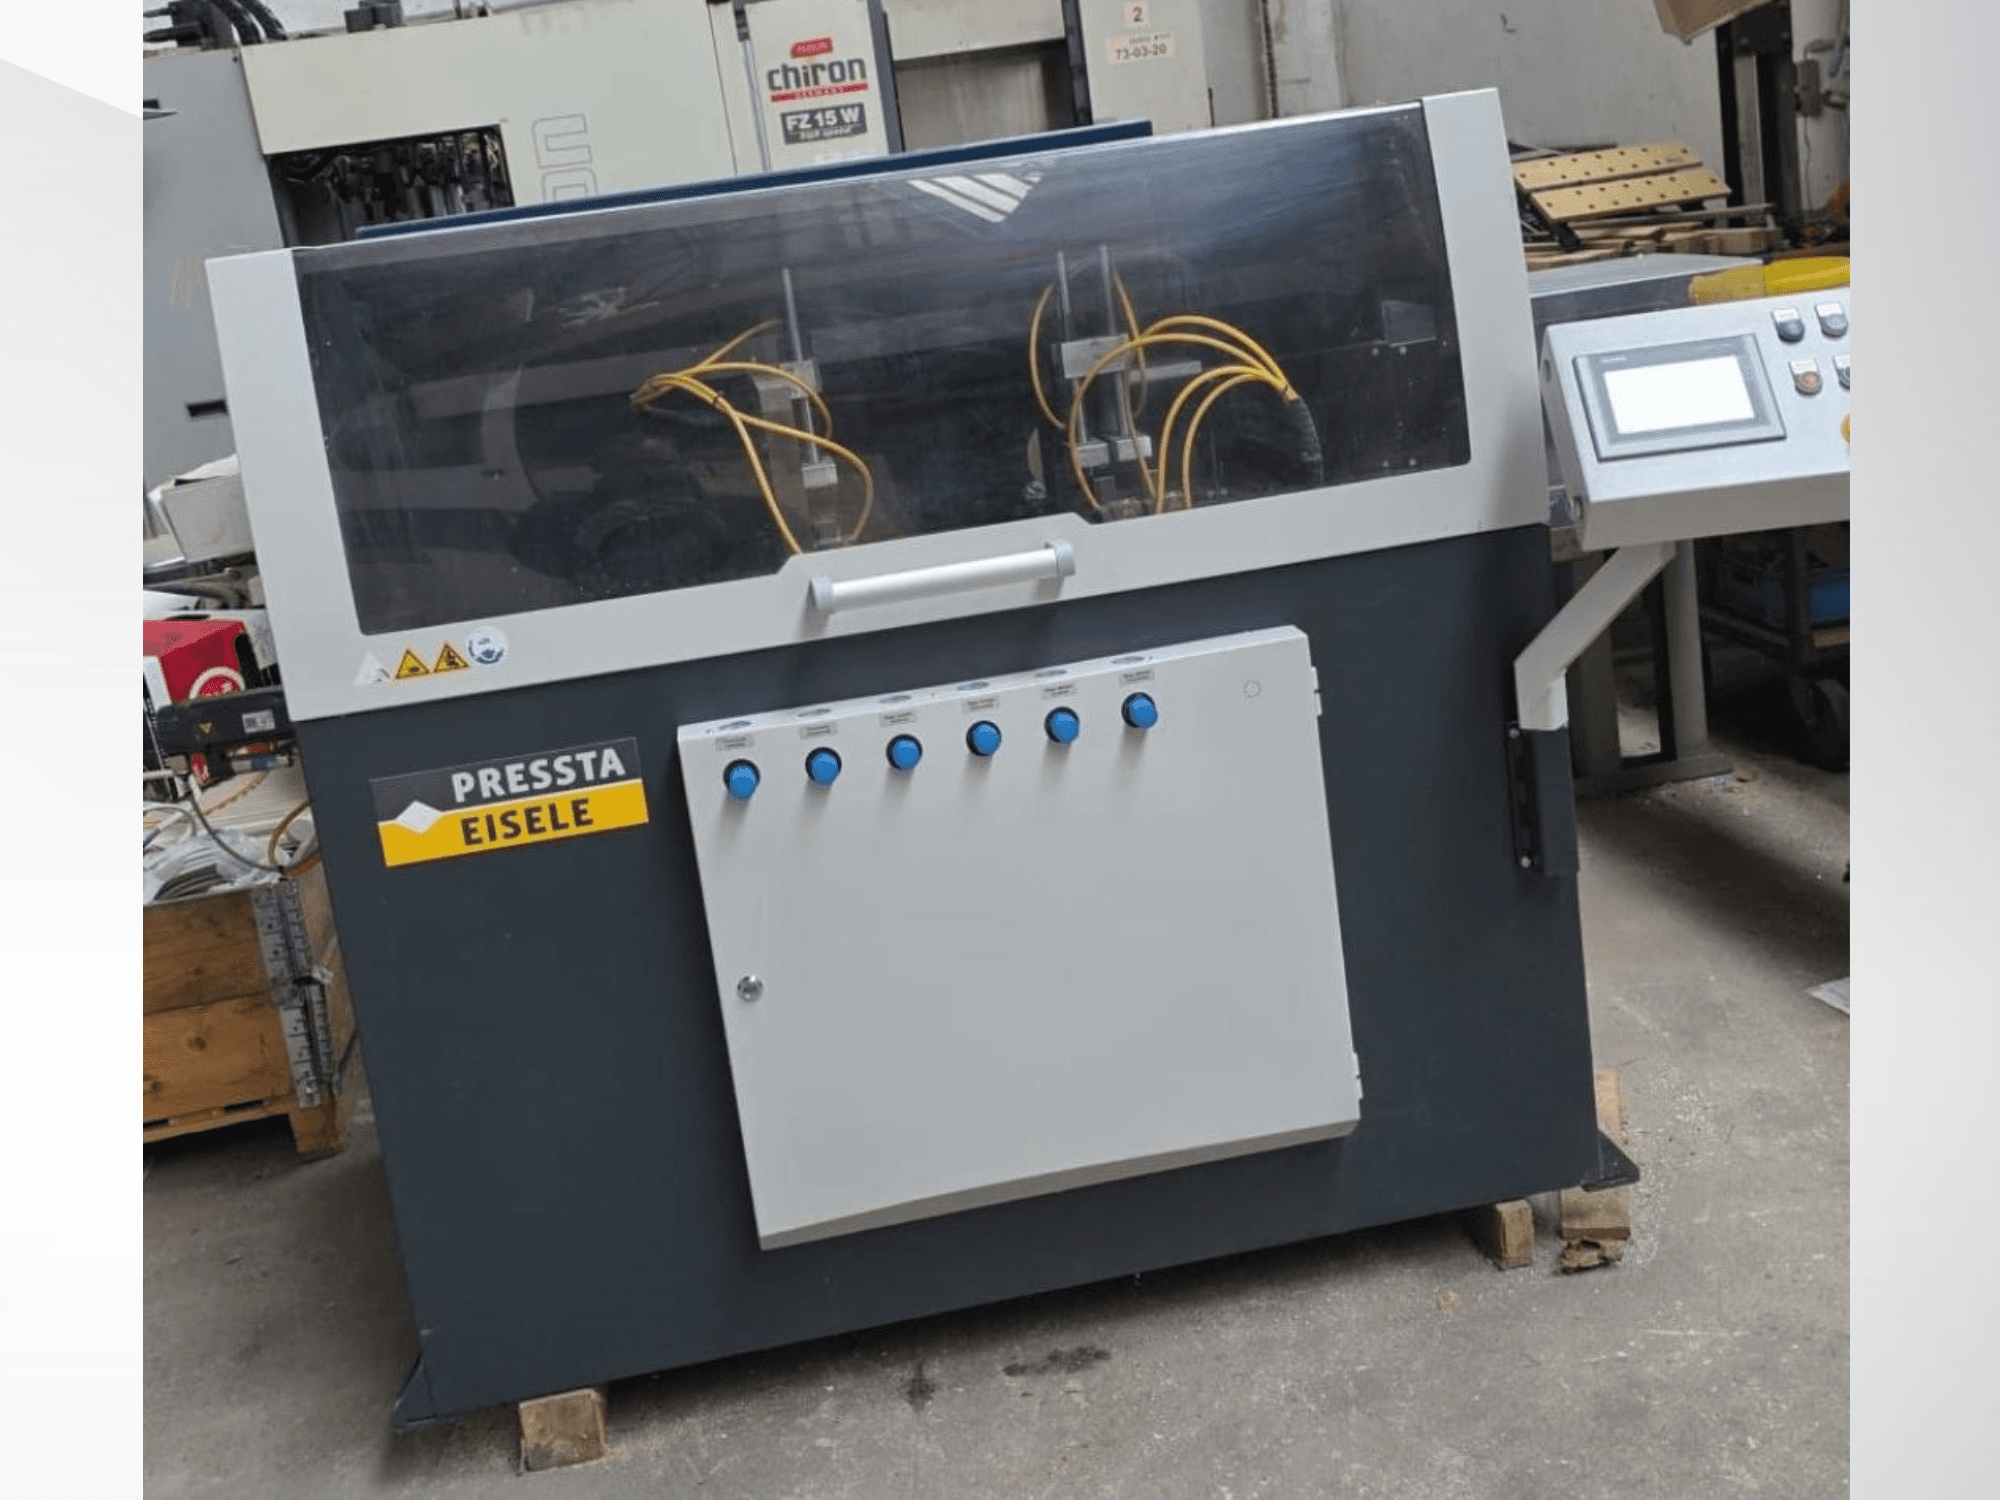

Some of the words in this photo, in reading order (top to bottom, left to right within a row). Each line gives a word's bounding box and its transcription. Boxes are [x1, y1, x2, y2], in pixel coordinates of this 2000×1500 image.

[1132, 6, 1143, 22] 2
[767, 58, 867, 91] chiron
[785, 112, 812, 132] FZ
[814, 109, 838, 127] 15
[840, 106, 861, 123] W
[451, 748, 626, 803] PRESSTA
[461, 798, 594, 846] EISELE
